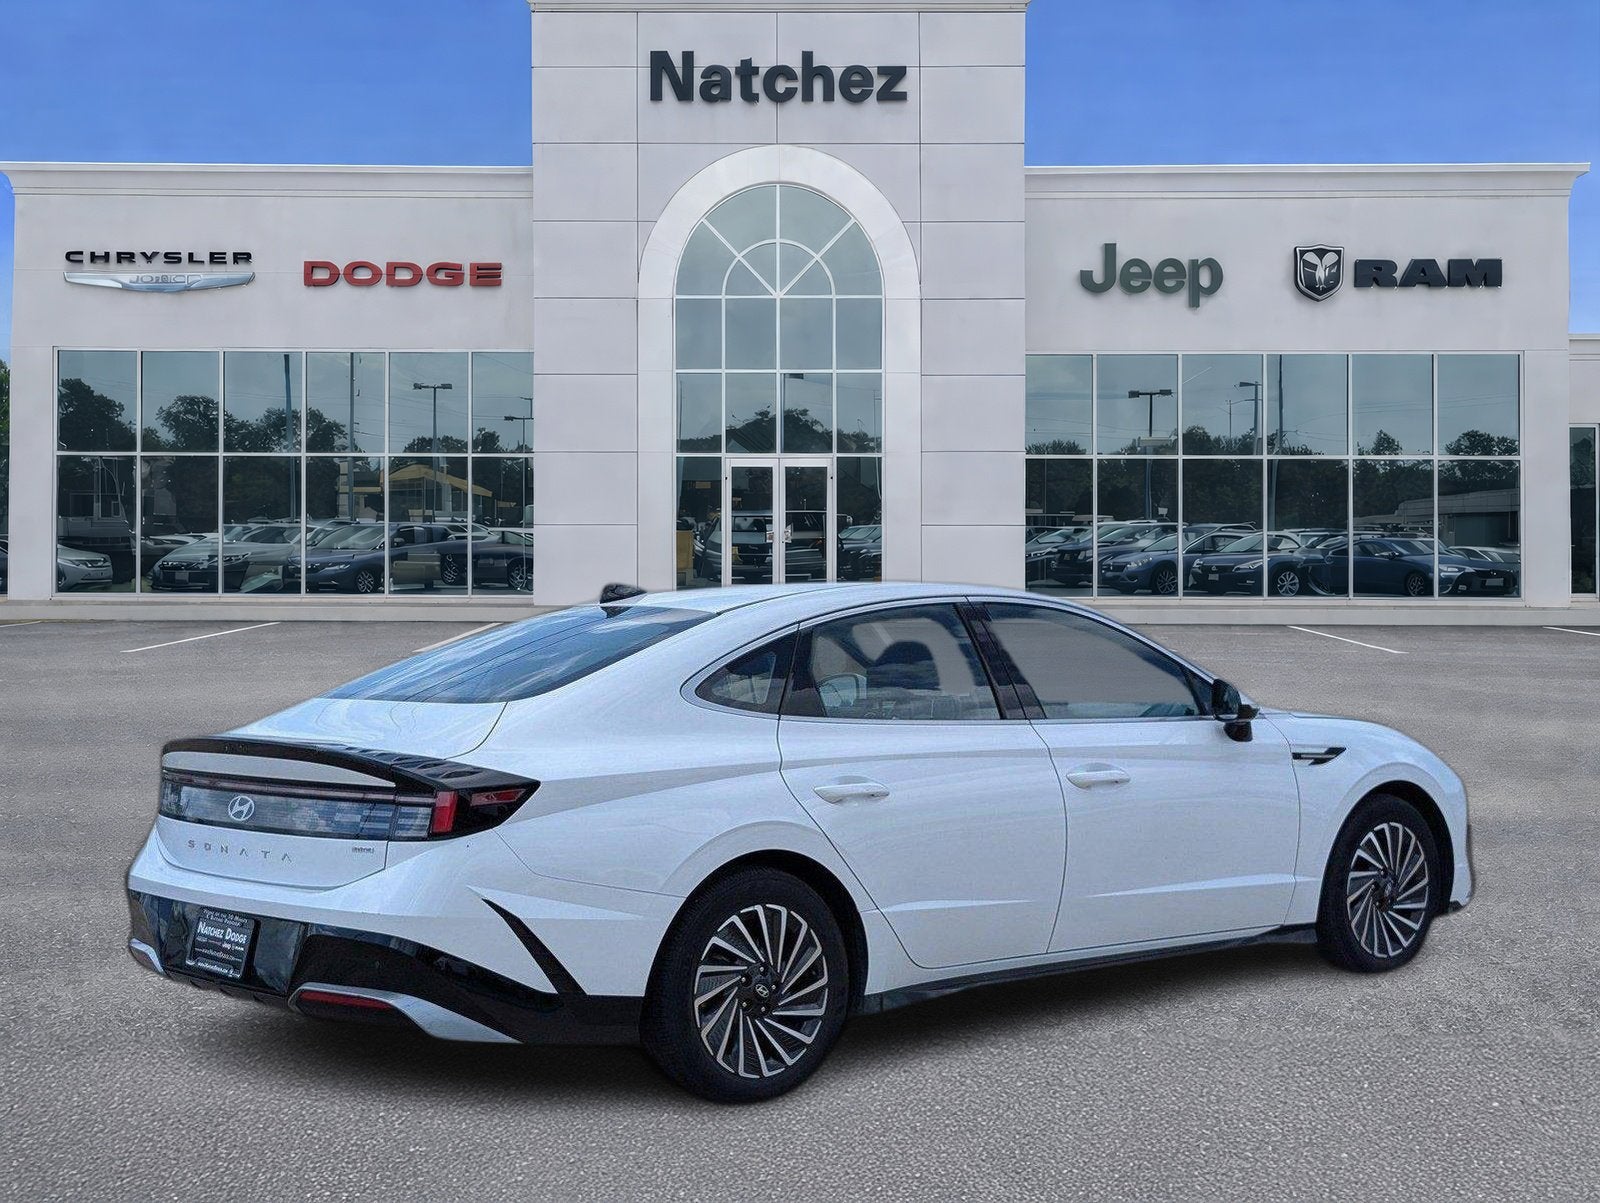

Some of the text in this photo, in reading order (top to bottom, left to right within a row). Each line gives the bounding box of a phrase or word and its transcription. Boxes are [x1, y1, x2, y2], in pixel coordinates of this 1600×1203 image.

[650, 50, 908, 103] Natchez
[65, 250, 253, 266] CHRYSLER
[303, 260, 502, 287] DODGE
[1080, 242, 1224, 308] Jeep
[1354, 258, 1503, 289] RAM
[187, 839, 294, 863] SONATA
